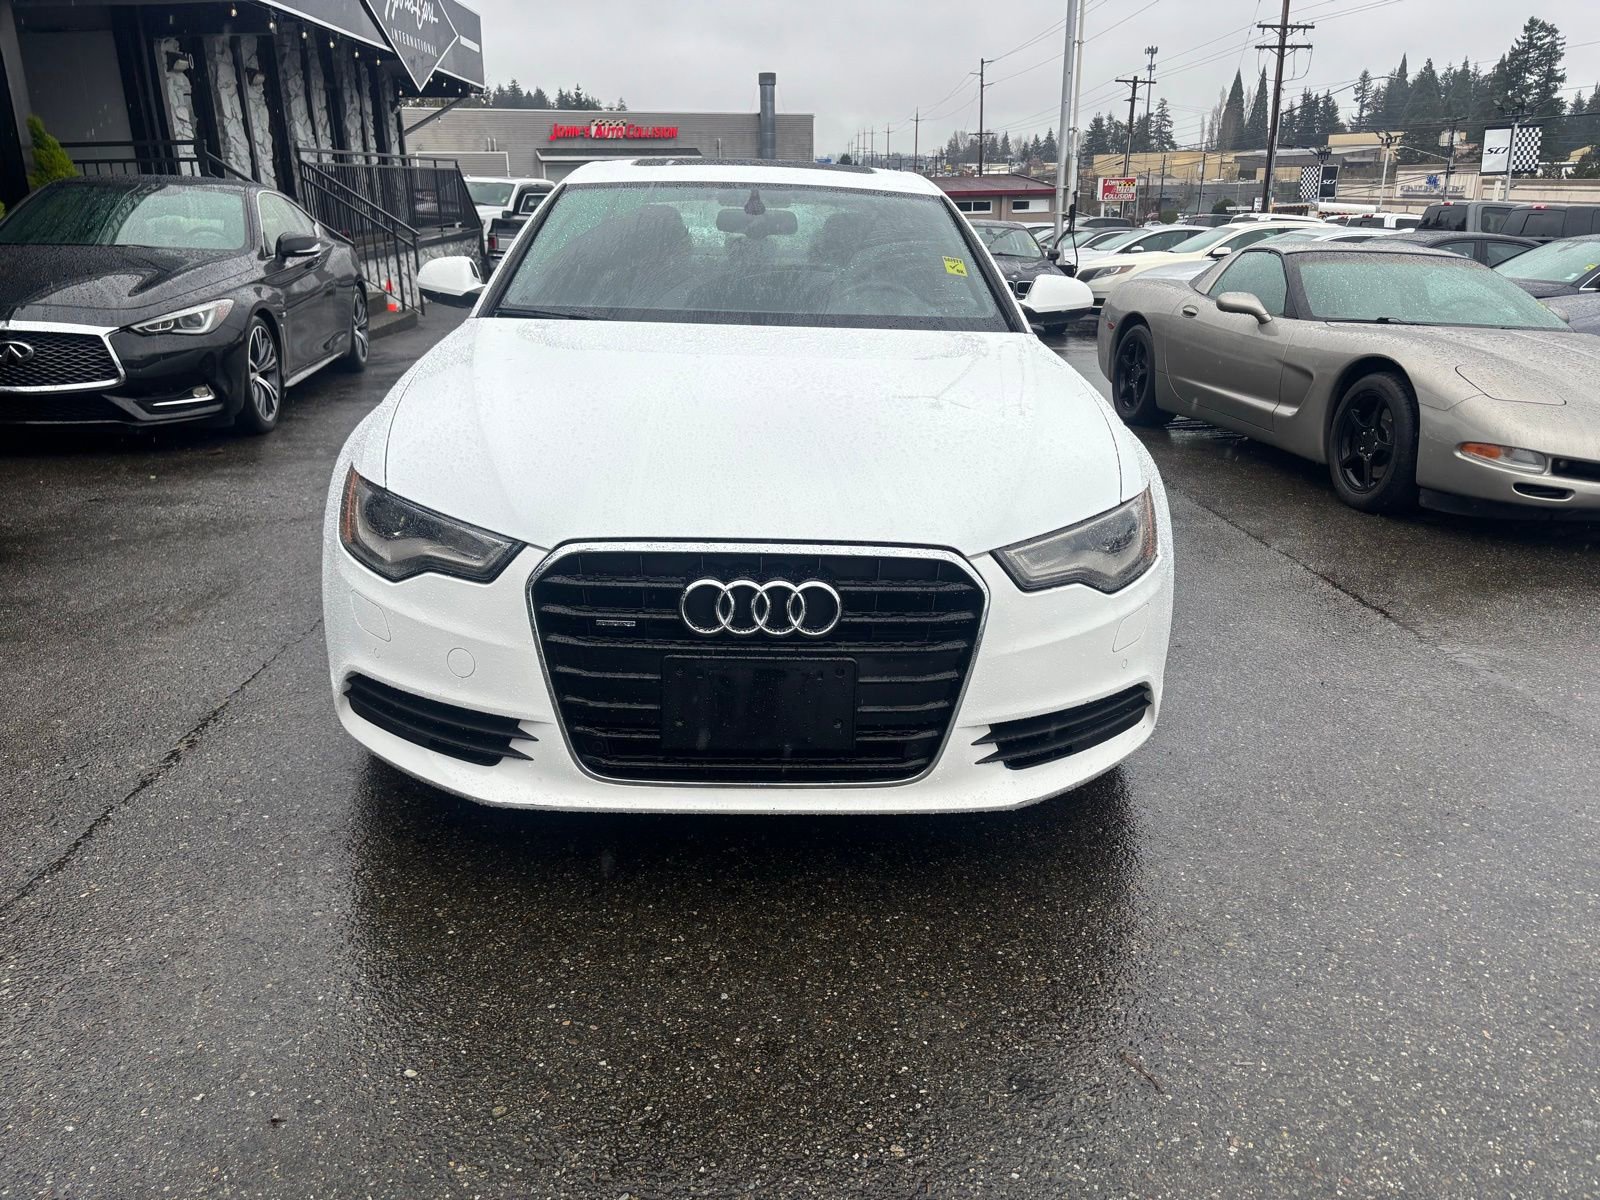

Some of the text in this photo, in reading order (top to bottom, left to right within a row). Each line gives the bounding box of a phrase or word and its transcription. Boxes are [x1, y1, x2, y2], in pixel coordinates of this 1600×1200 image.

[391, 27, 438, 58] INTERNATIONAL
[626, 123, 679, 140] COLLISION
[1104, 192, 1134, 200] COLLISION
